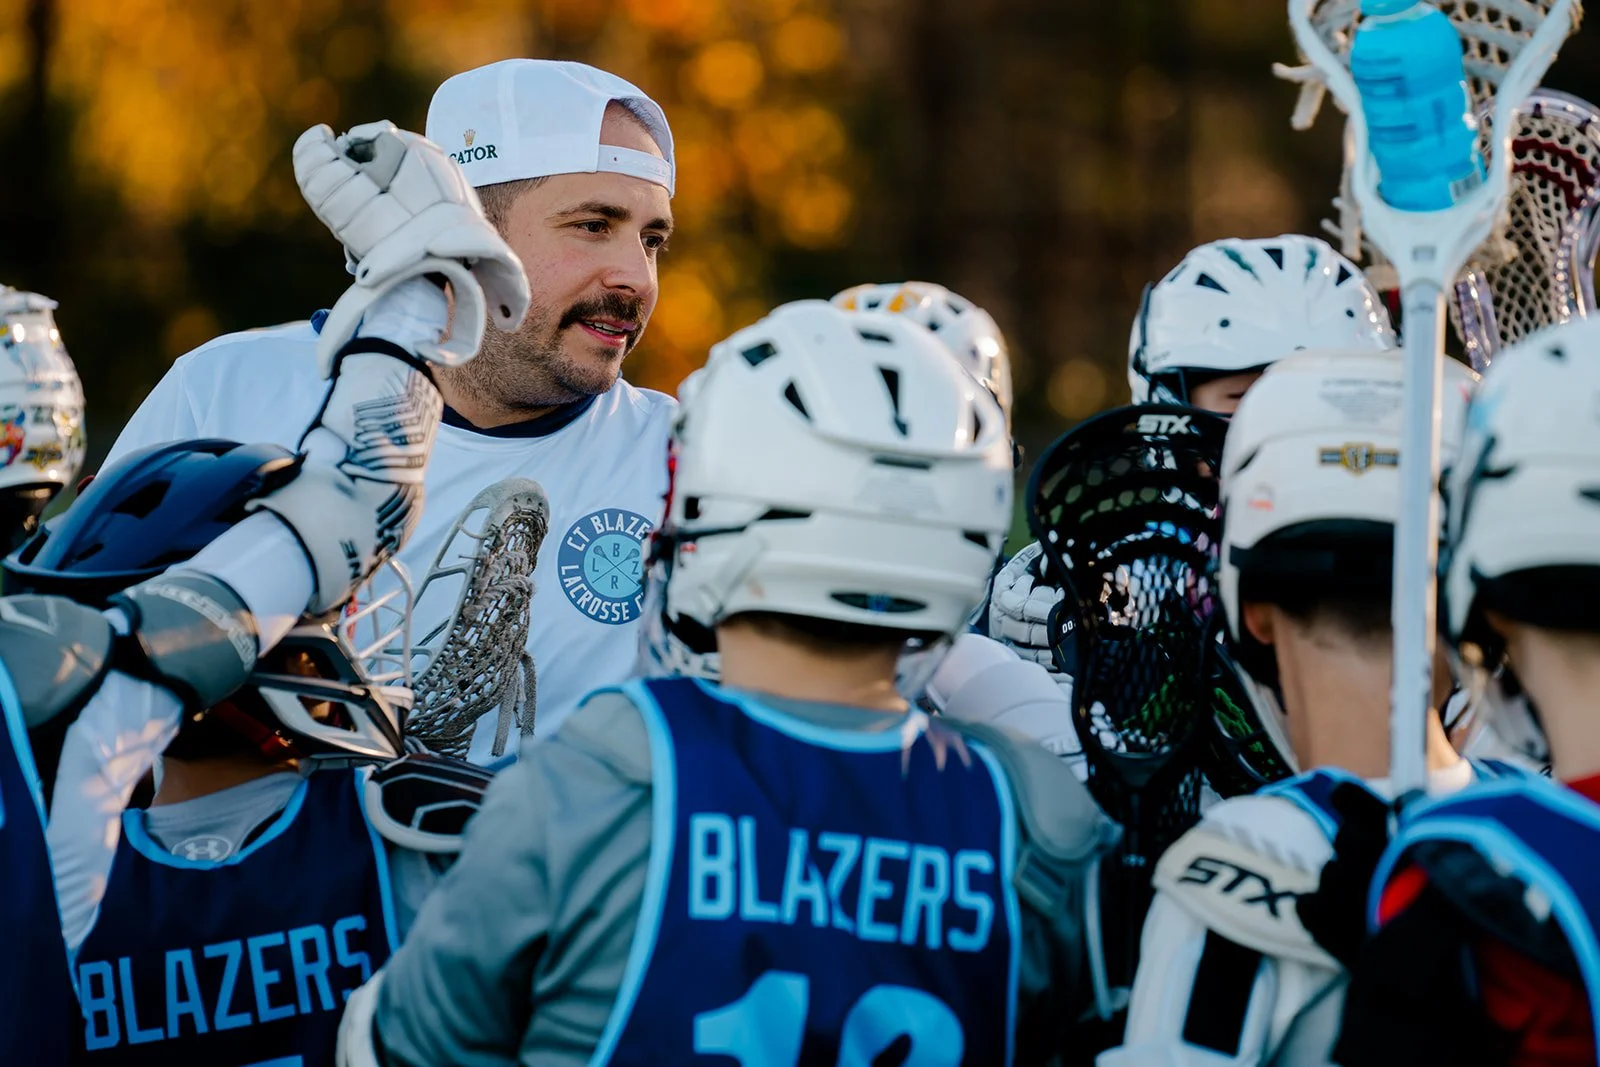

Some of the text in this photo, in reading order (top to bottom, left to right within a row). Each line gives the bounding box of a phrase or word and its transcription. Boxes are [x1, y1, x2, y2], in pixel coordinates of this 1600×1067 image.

[1136, 413, 1192, 435] STX
[567, 513, 651, 552] CT BLAZE
[613, 543, 620, 557] B
[592, 558, 639, 575] L Z
[611, 575, 618, 590] R
[561, 564, 630, 622] LACROSSE
[688, 811, 995, 952] BLAZERS
[1177, 855, 1299, 919] STX
[79, 914, 372, 1051] BLAZERS
